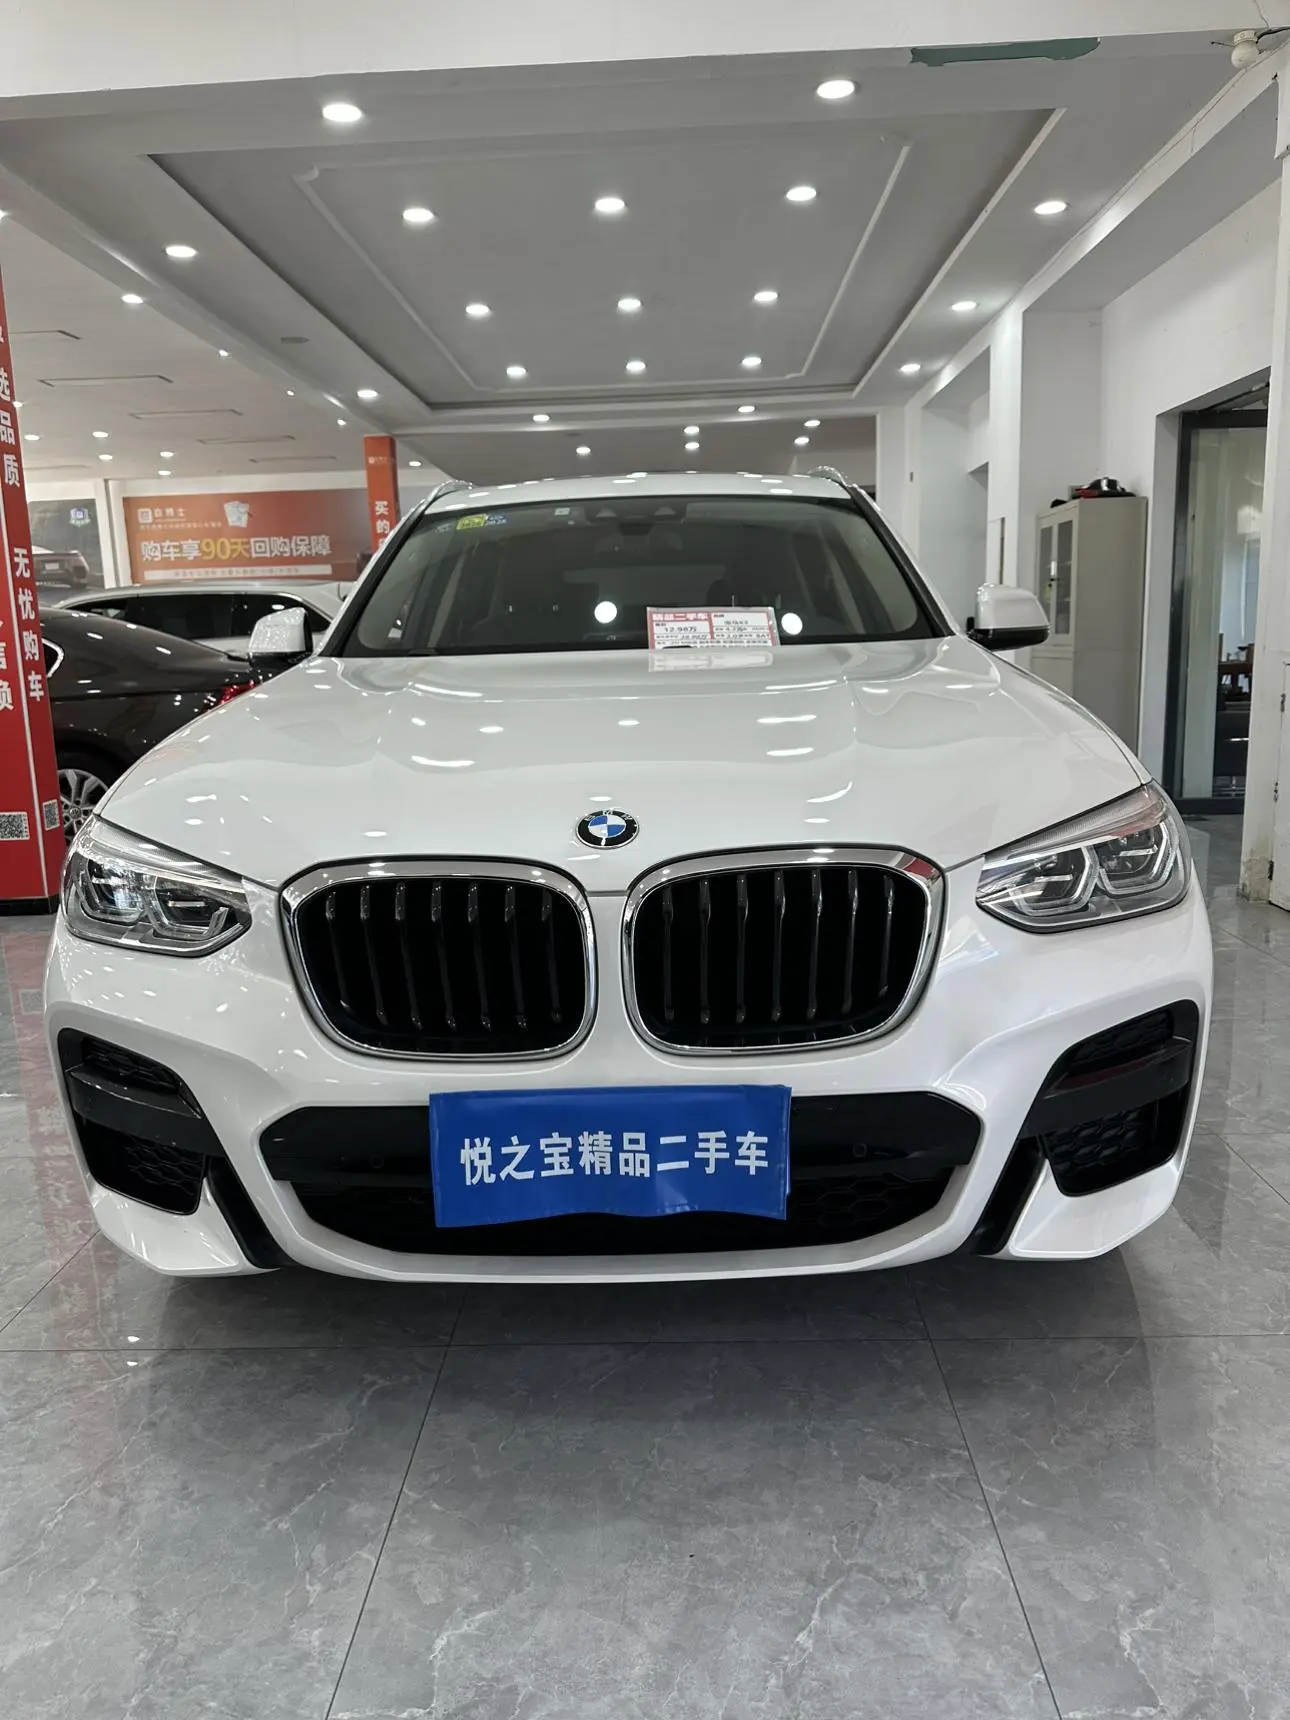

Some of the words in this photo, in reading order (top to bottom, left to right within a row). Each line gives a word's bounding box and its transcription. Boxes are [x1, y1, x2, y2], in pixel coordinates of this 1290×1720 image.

[0, 326, 20, 488] 选品质
[13, 547, 45, 702] 无忧购车
[374, 500, 391, 550] 买的
[141, 535, 332, 562] 购车享90天回购保障
[460, 1131, 769, 1186] 悦之宝精品二手车
